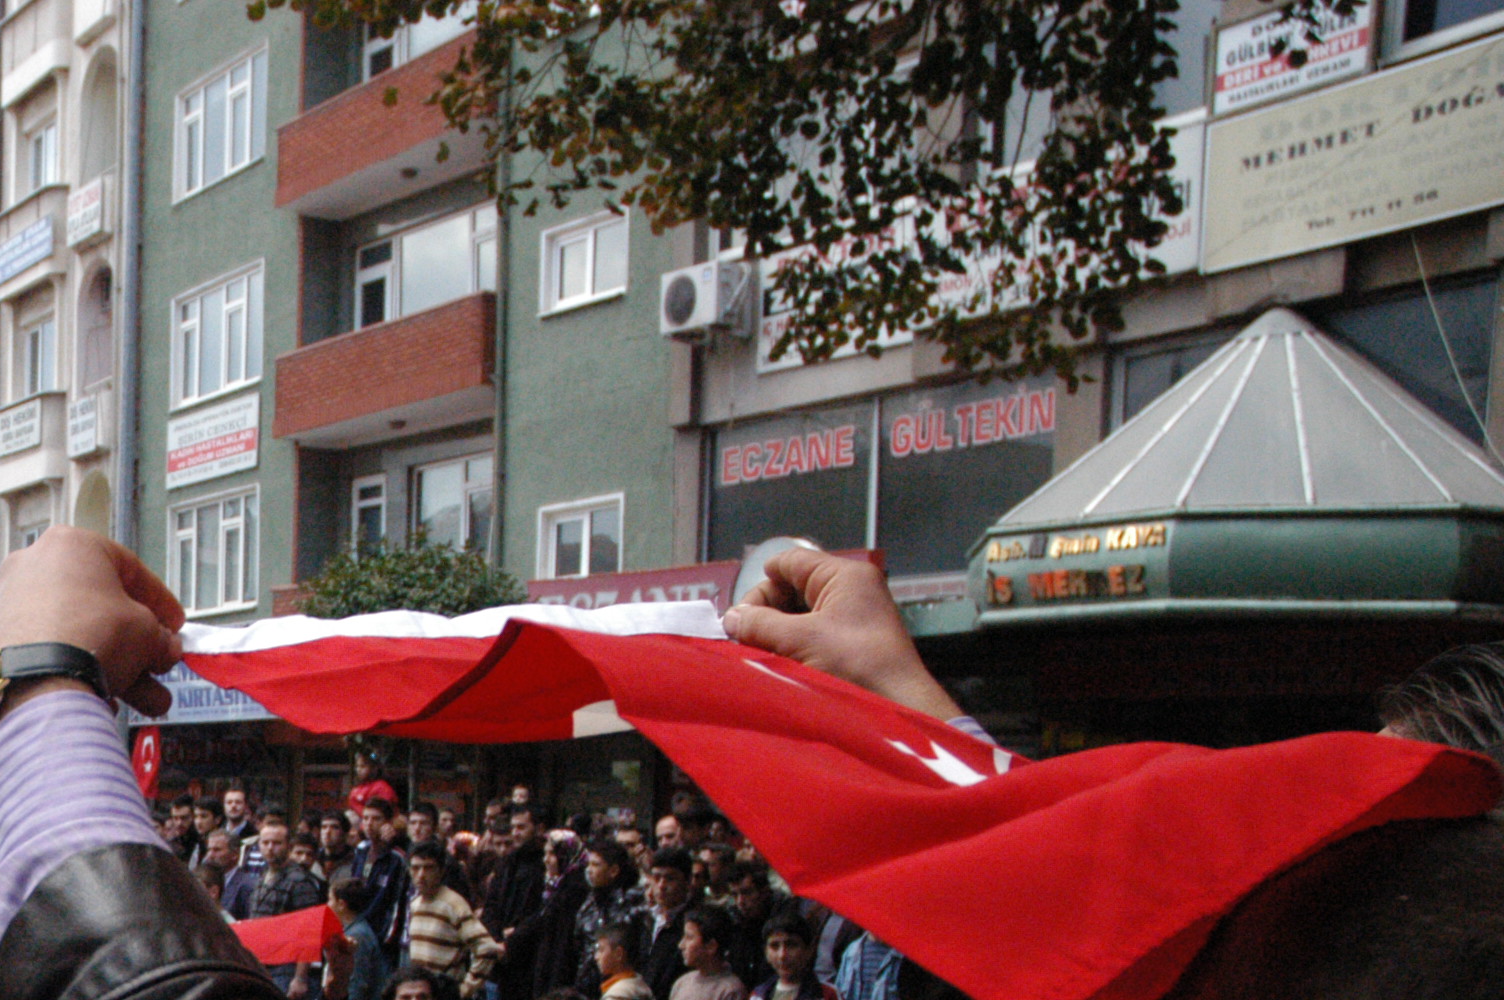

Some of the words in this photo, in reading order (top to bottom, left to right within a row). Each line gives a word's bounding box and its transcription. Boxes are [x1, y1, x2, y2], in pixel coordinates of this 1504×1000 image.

[1241, 120, 1382, 172] MEHMET
[720, 425, 855, 486] ECZANE
[1106, 523, 1167, 551] KAYA
